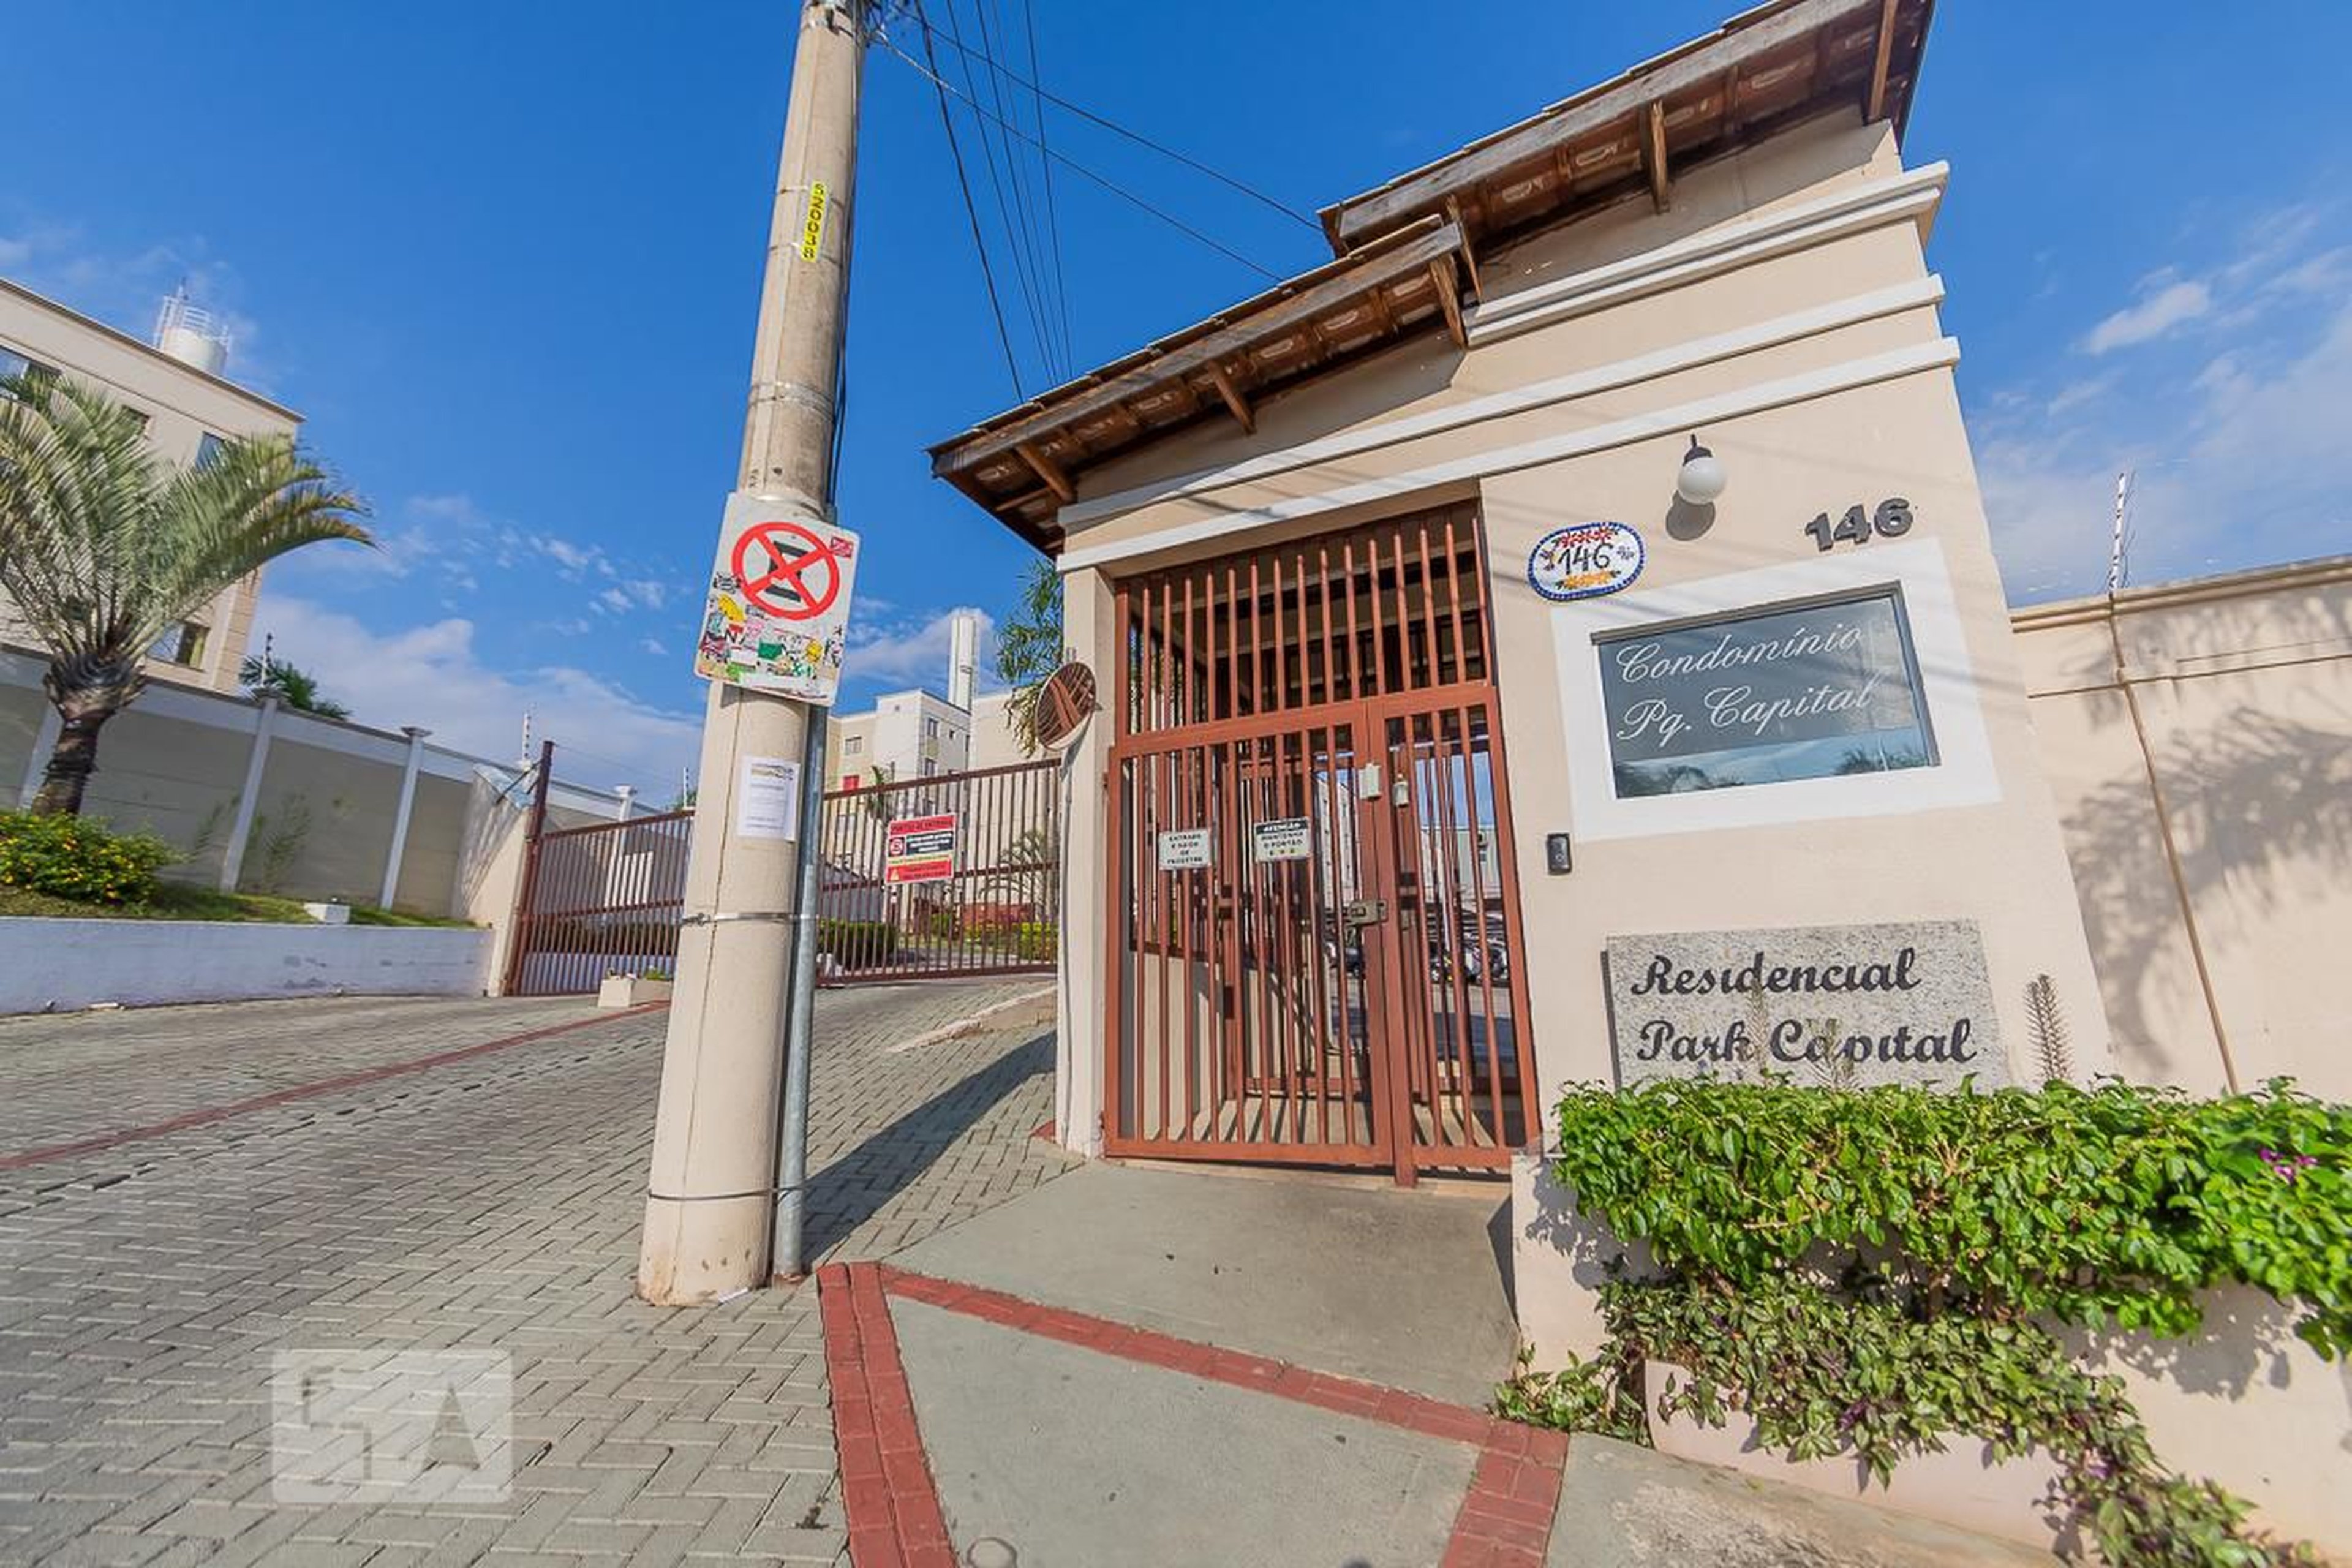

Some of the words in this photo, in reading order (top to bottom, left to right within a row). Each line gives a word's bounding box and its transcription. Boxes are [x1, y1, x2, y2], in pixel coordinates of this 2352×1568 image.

[1805, 497, 1913, 552] 146
[1558, 542, 1614, 575] 146
[1616, 621, 1863, 684] Condomínio
[1703, 673, 1883, 736] Capital
[1630, 947, 1922, 995] Residencial
[1636, 1019, 1754, 1063] Park
